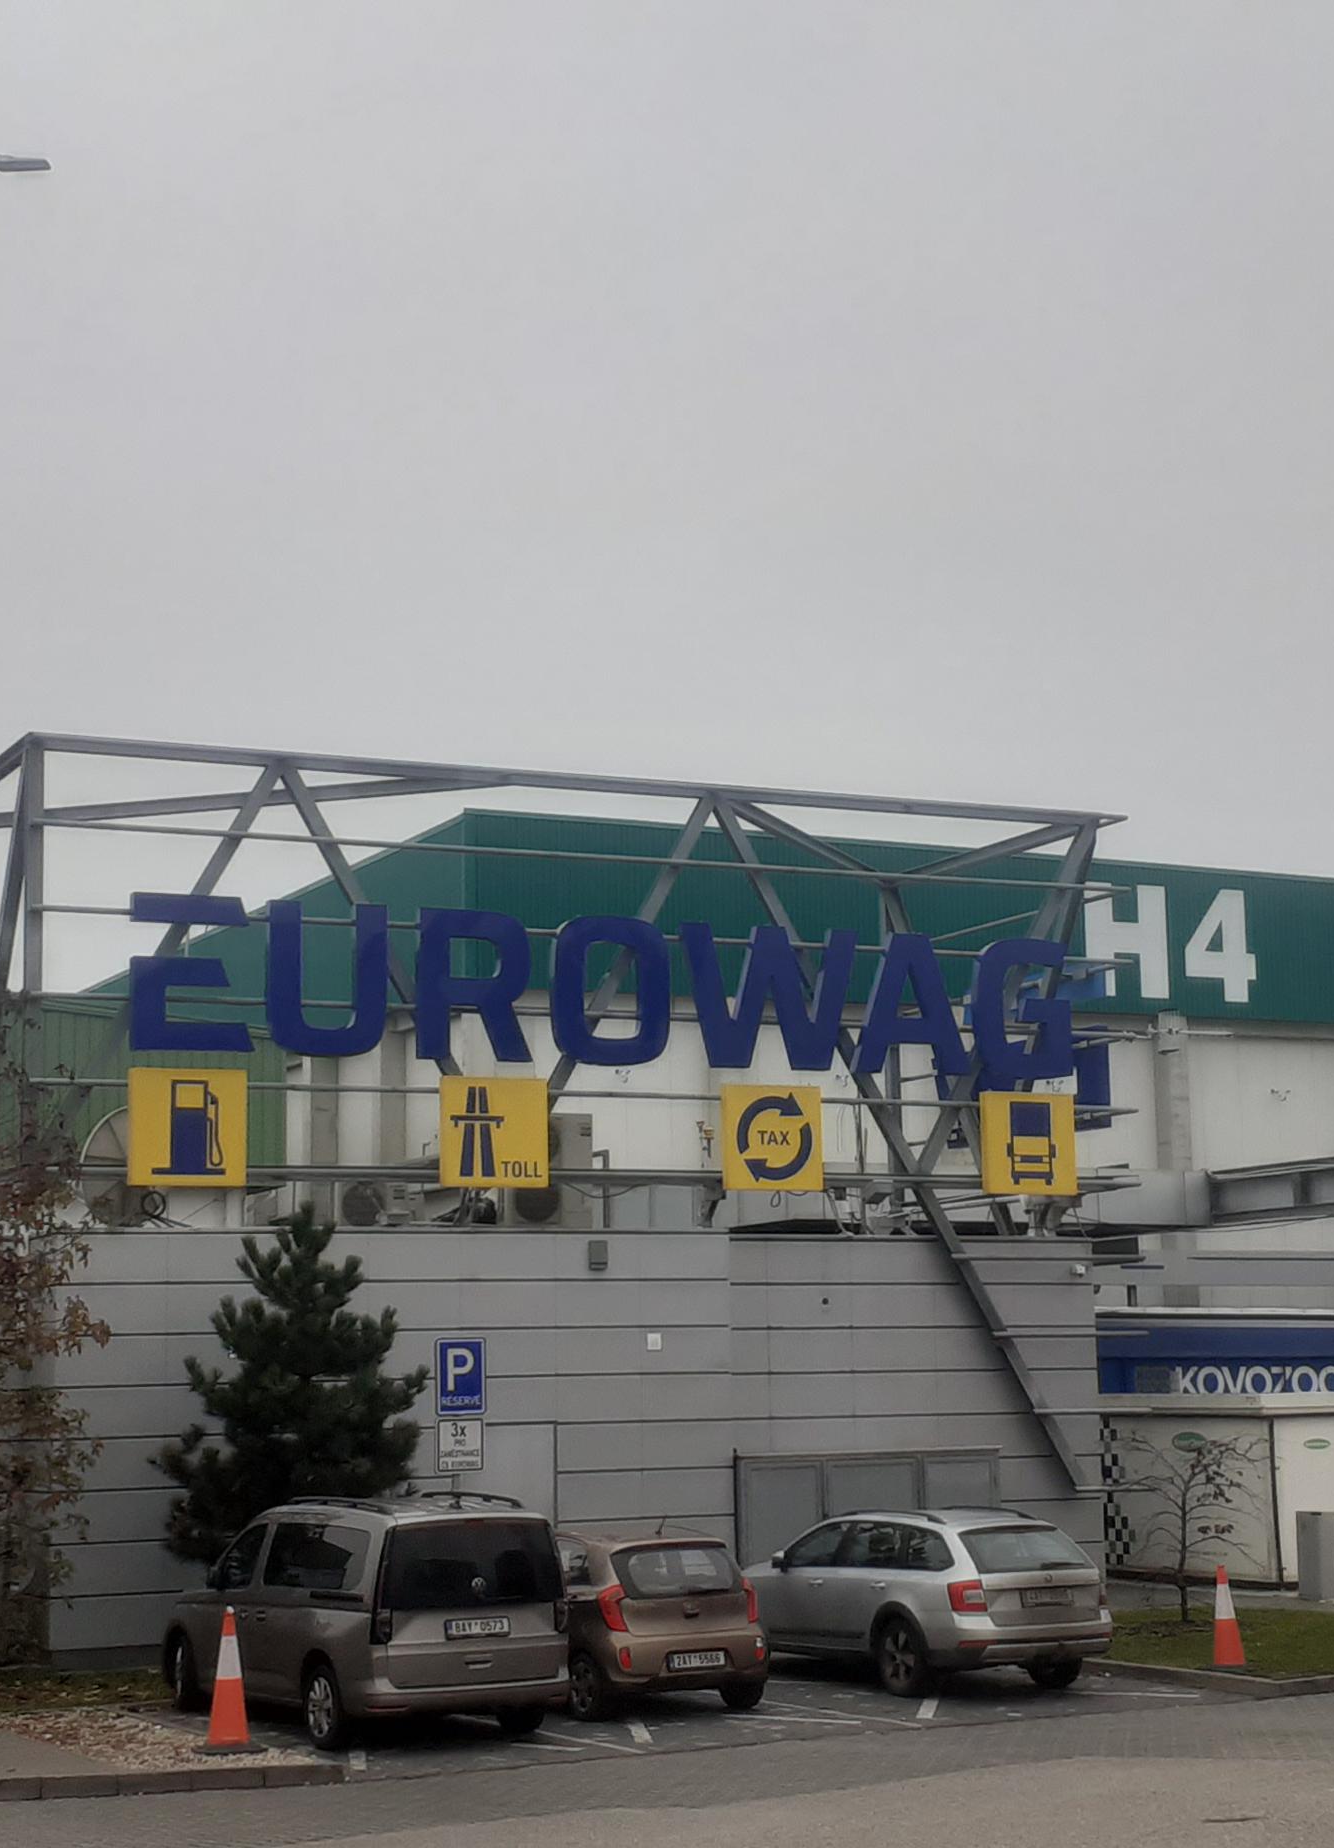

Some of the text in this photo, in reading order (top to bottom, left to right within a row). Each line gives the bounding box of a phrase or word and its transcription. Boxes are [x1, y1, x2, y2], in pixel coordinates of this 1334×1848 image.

[1084, 881, 1256, 1003] H4
[130, 891, 1074, 1081] EUROWAG
[758, 1129, 791, 1147] TAX
[501, 1160, 543, 1180] TOLL
[447, 1347, 475, 1392] P
[450, 1422, 467, 1438] 3x
